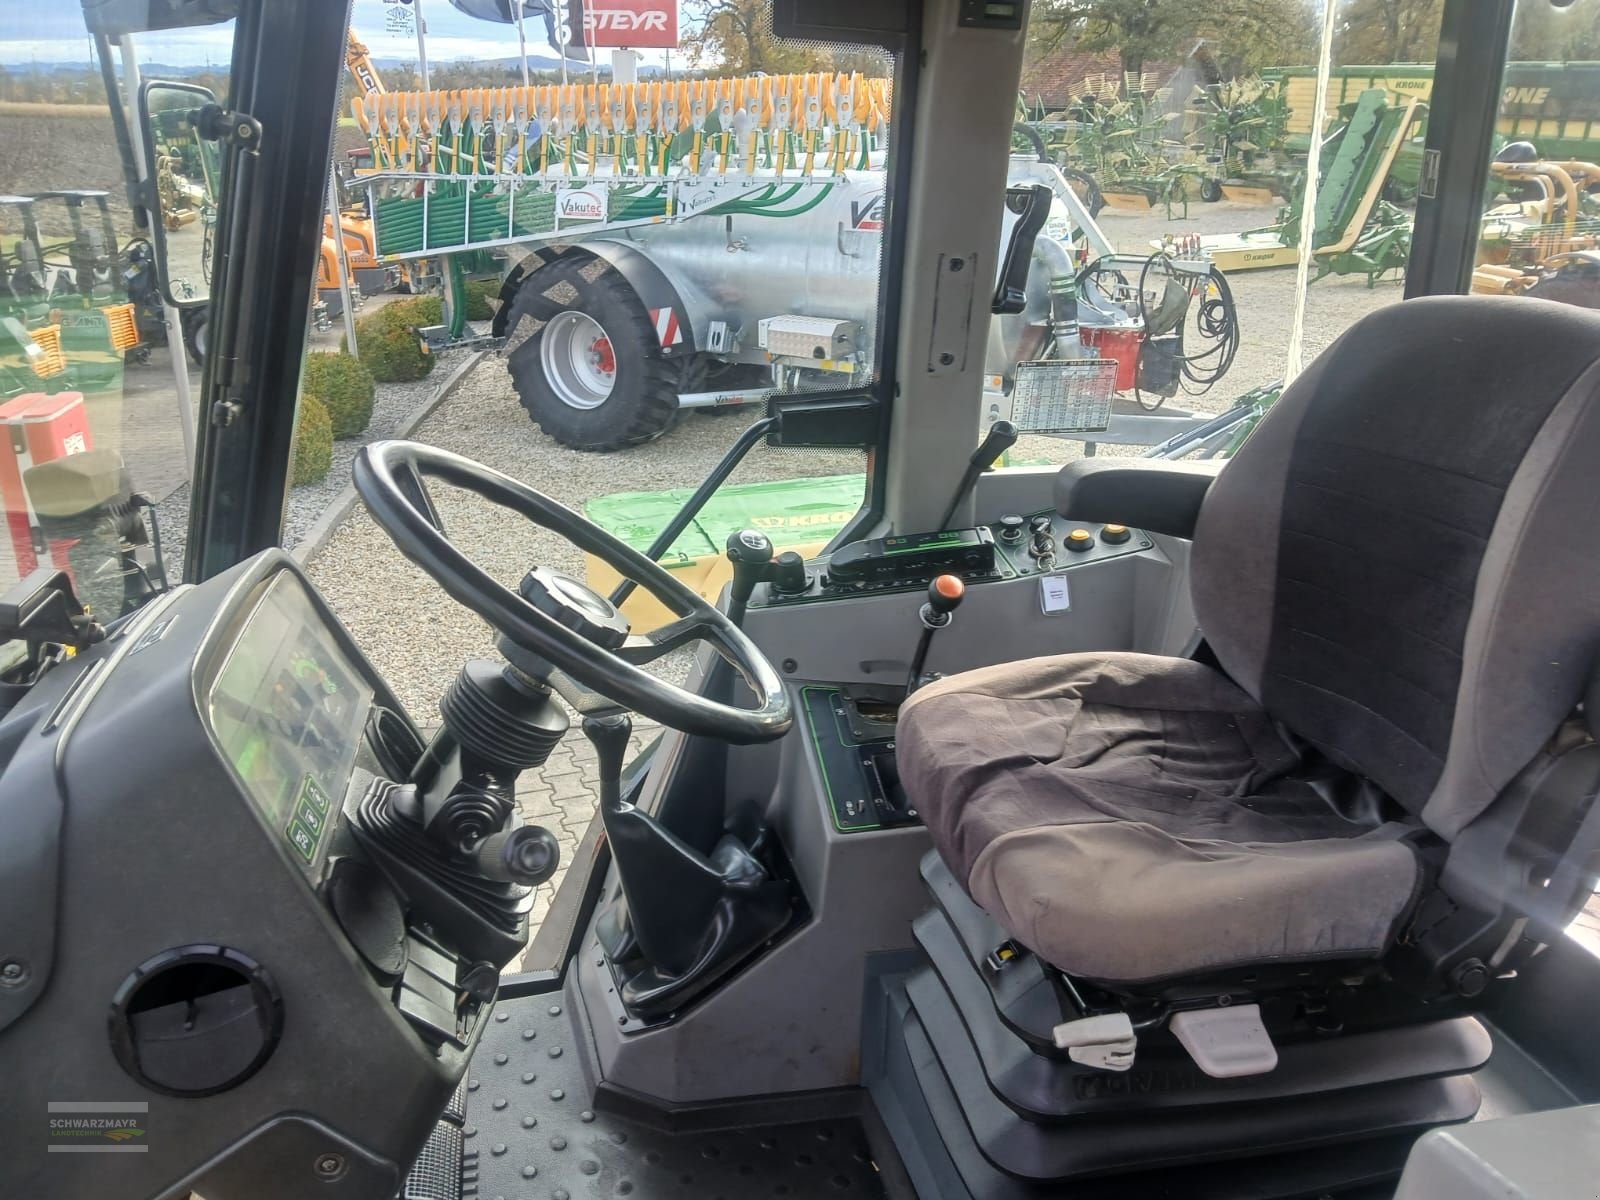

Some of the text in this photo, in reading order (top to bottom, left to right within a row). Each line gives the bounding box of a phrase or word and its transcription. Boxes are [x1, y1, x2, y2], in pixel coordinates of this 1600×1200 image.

[583, 9, 668, 31] STEYR
[1395, 81, 1427, 89] KRONE
[560, 198, 602, 216] Vakutec
